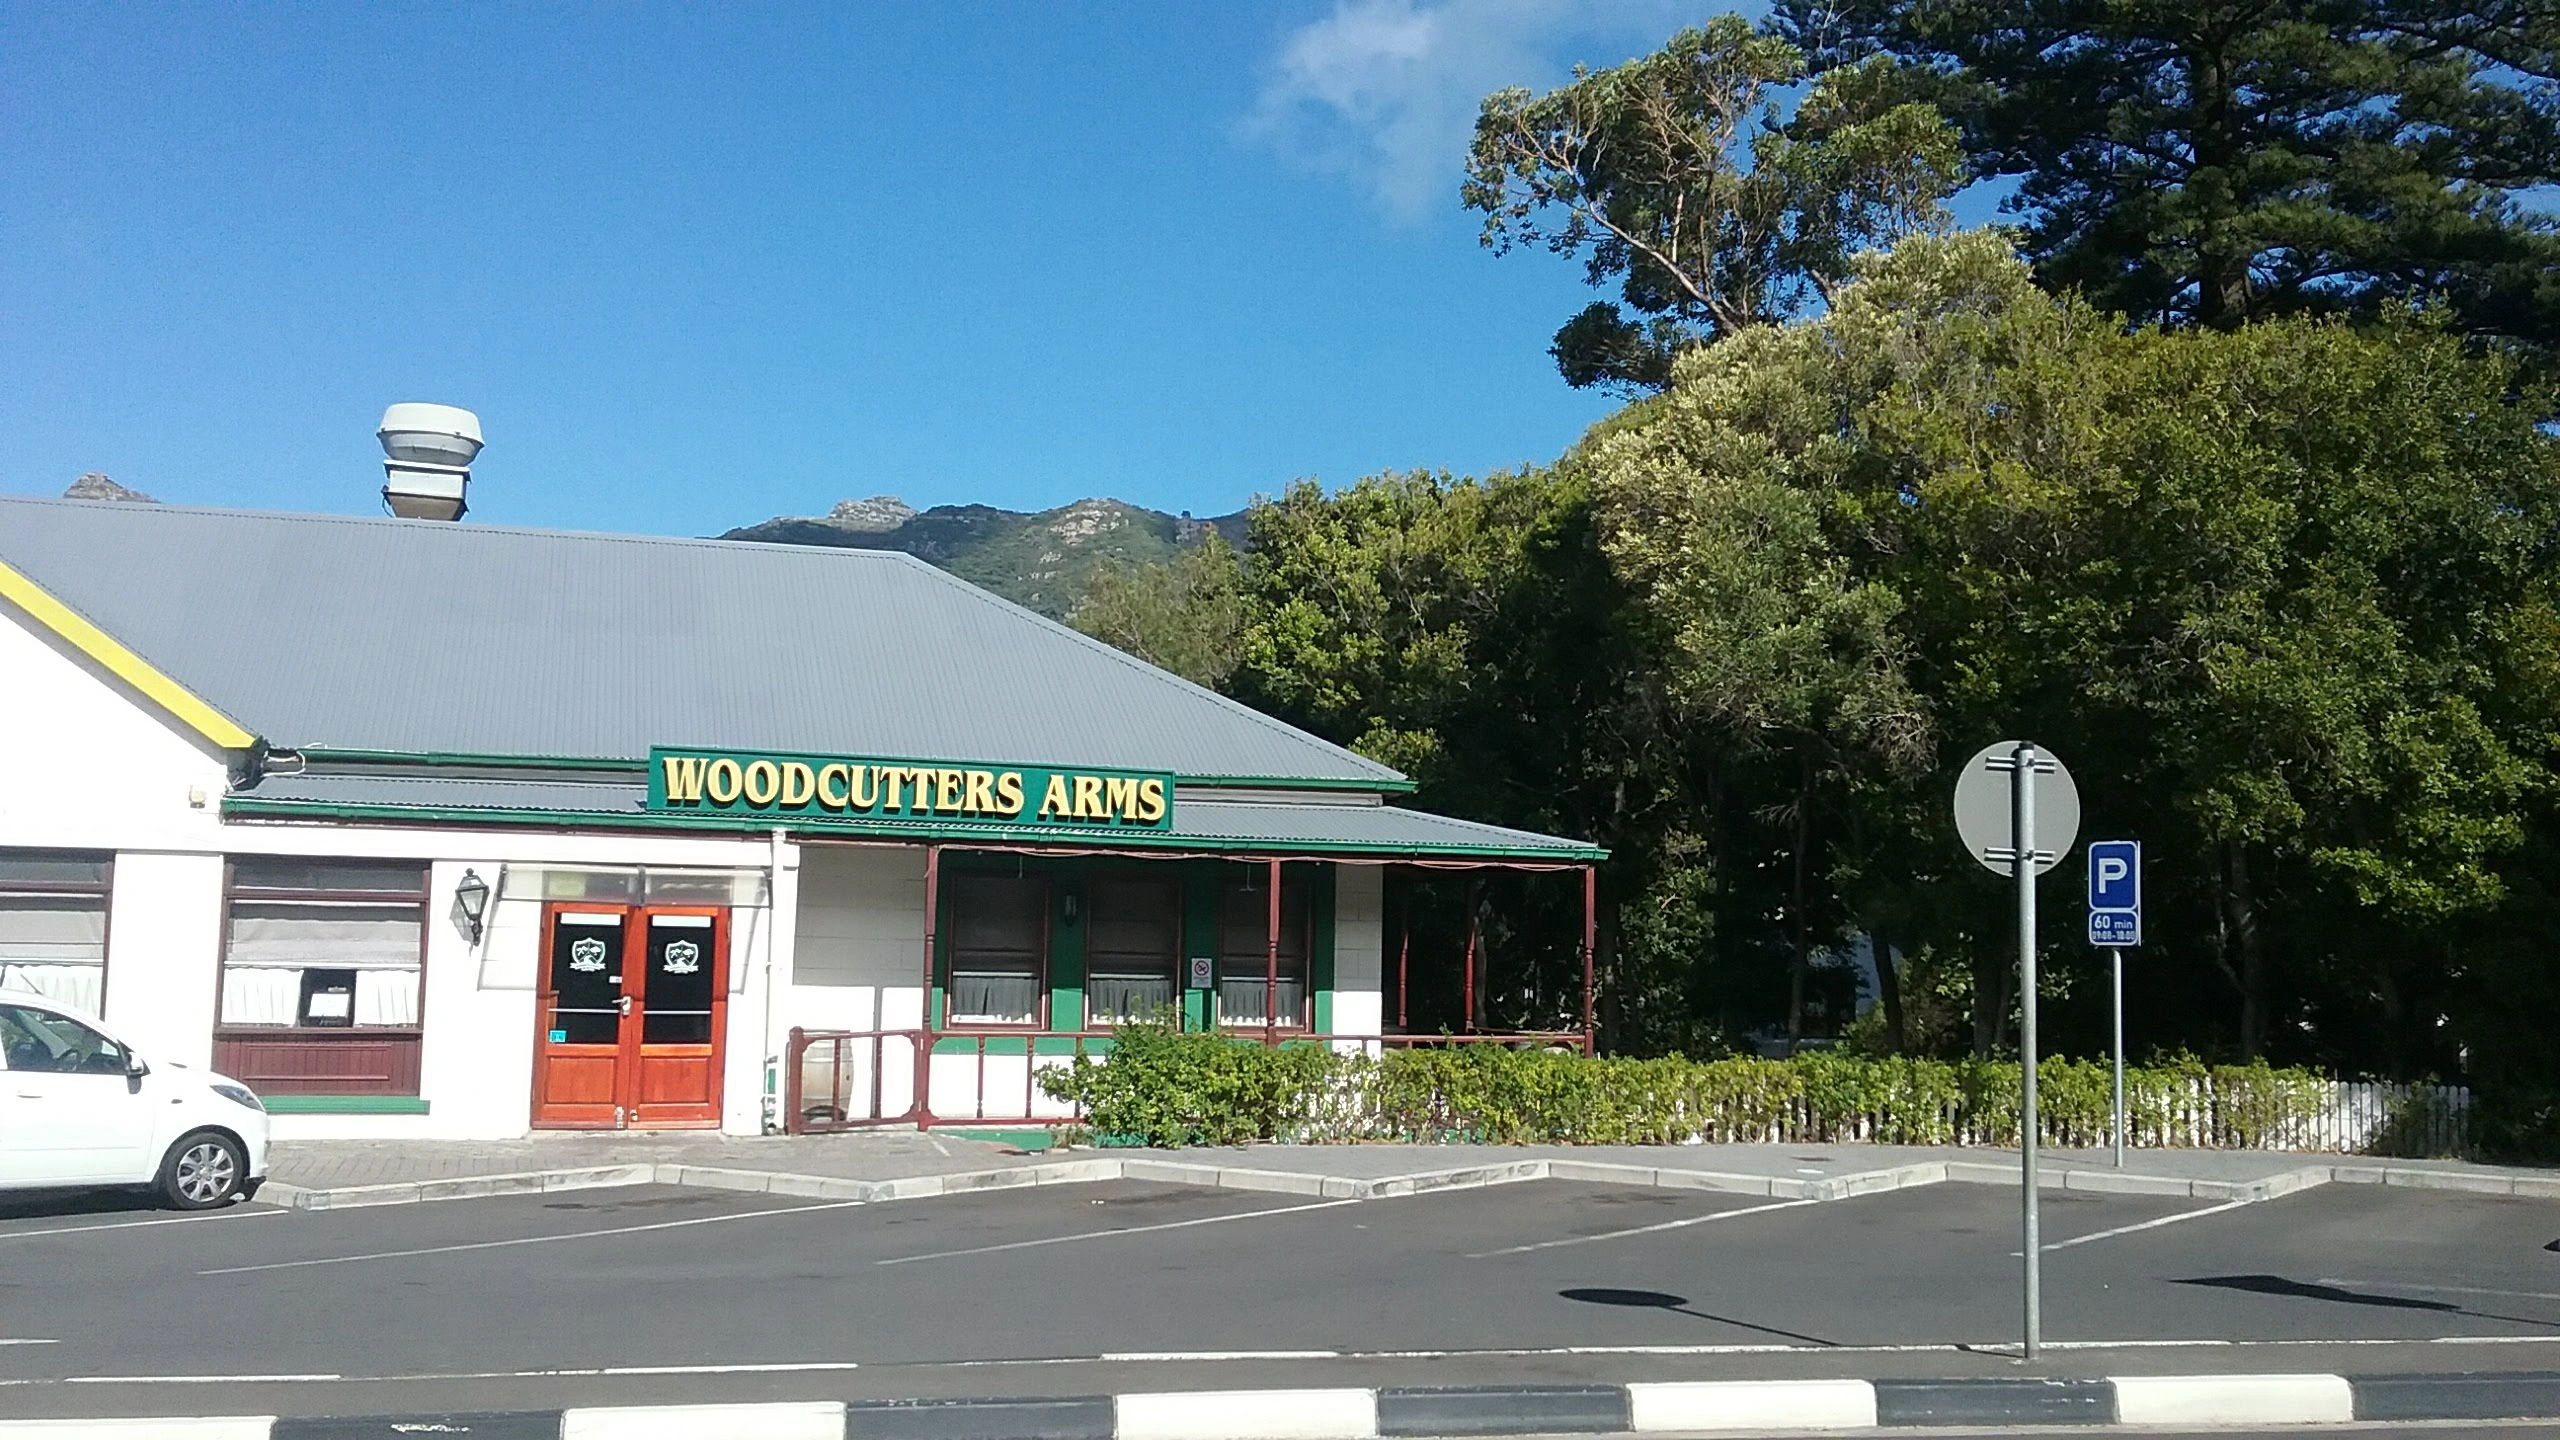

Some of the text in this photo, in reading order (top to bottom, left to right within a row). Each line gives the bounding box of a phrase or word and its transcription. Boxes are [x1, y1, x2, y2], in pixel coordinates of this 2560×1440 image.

[663, 757, 1166, 821] WOODCUTTERS ARMS
[2098, 858, 2128, 894] P
[2094, 915, 2133, 929] 60 min
